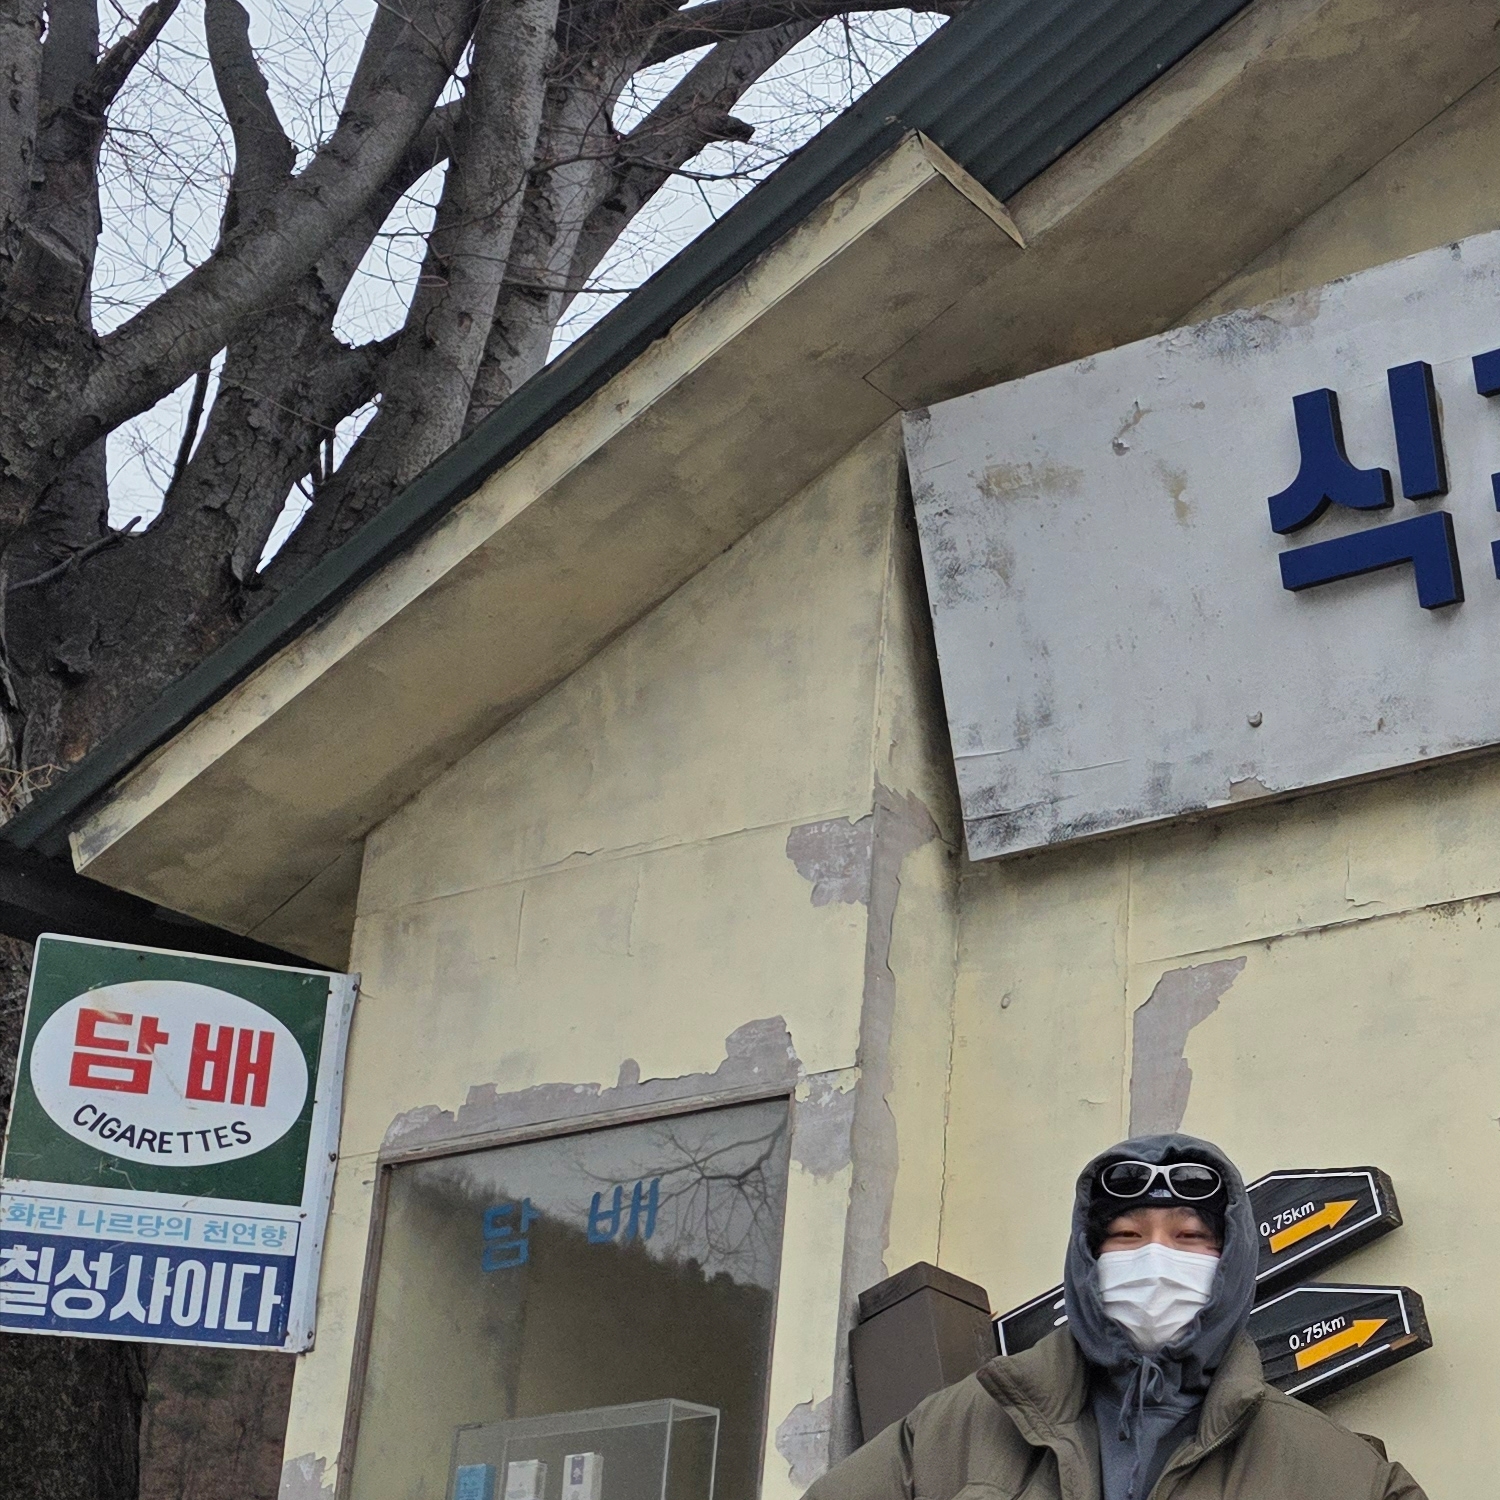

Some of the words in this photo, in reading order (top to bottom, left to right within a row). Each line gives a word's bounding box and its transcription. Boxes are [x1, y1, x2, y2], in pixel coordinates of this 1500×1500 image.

[73, 1103, 252, 1155] CIGARETTES
[6, 1202, 67, 1232] 화란
[76, 1207, 192, 1242] 나르당의
[203, 1219, 288, 1248] 천연향
[1259, 1199, 1316, 1238] 0.75km
[0, 1243, 282, 1333] 칠성사이다
[1288, 1314, 1347, 1352] 0.75km
